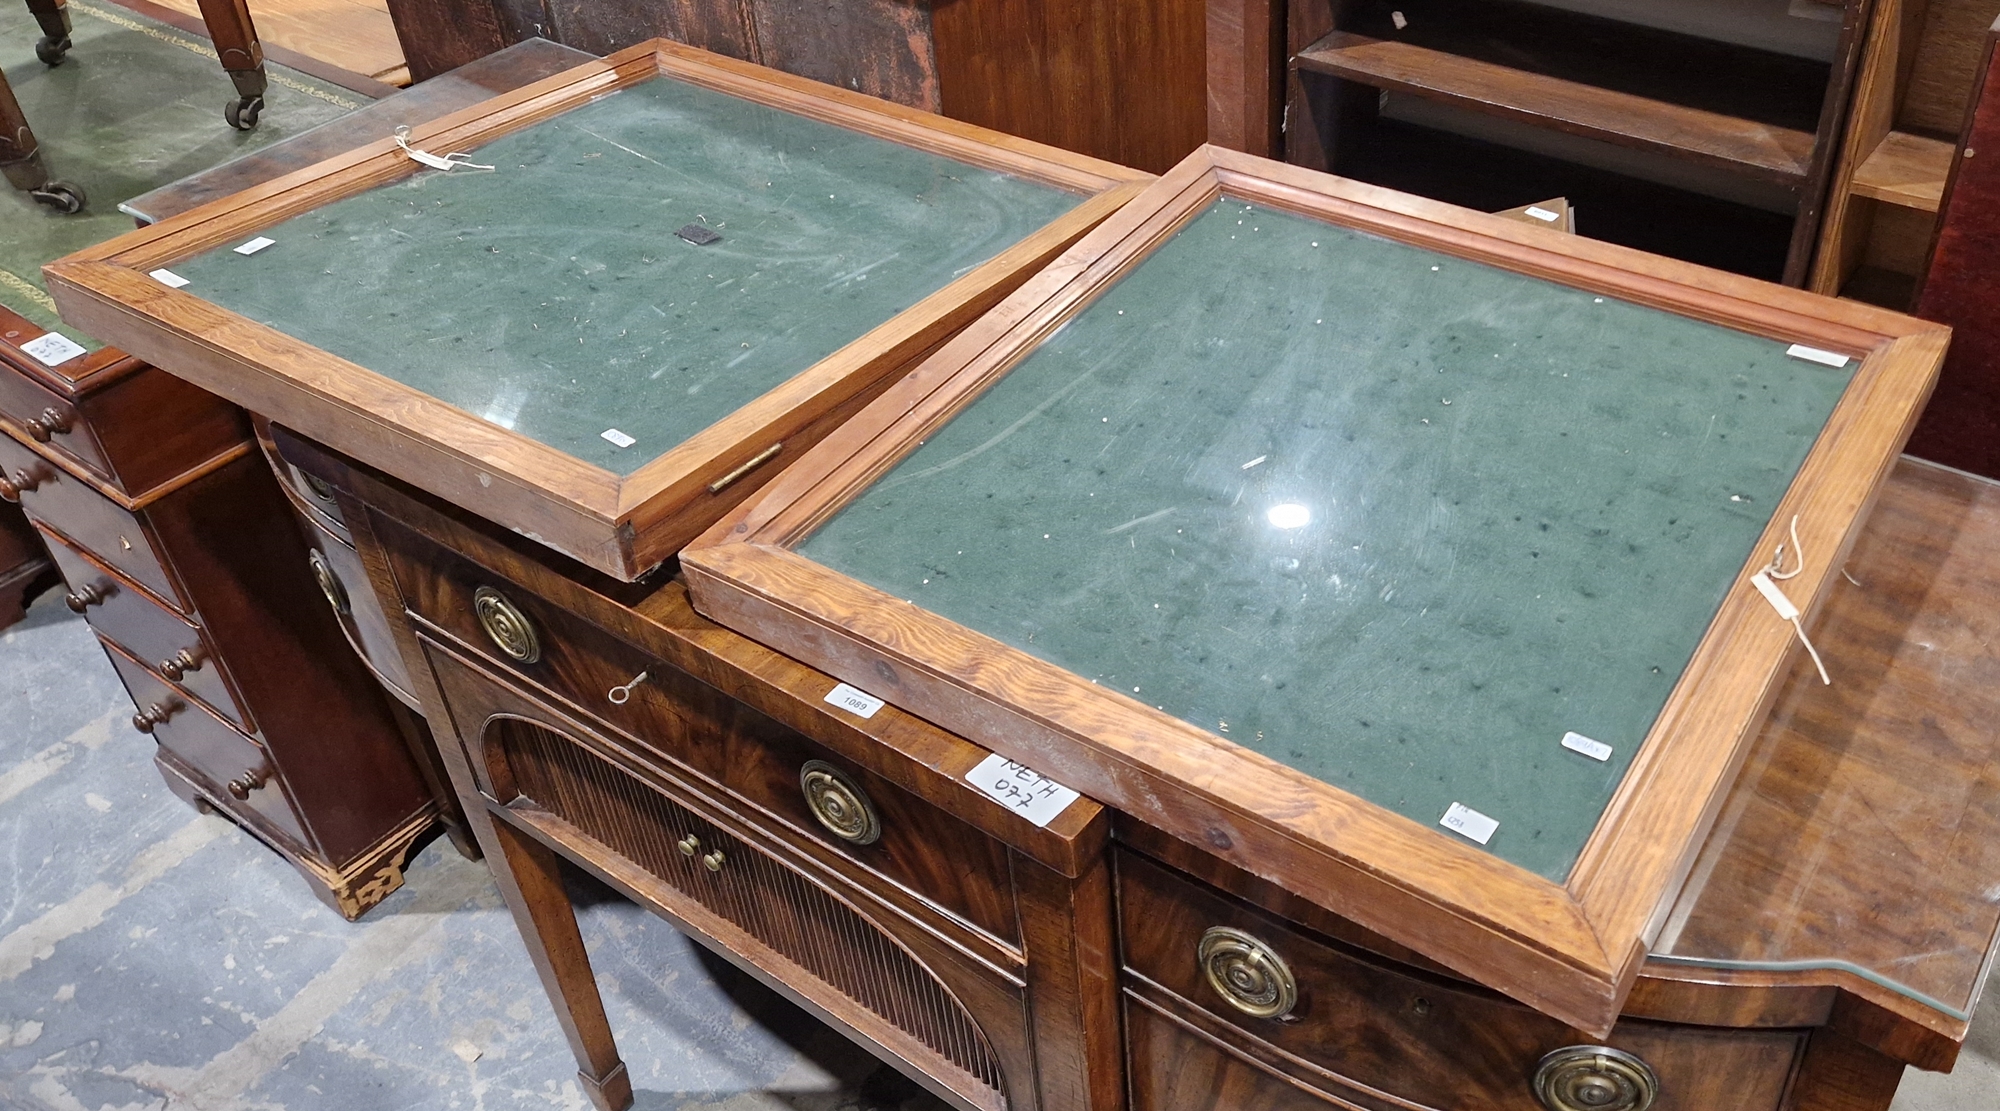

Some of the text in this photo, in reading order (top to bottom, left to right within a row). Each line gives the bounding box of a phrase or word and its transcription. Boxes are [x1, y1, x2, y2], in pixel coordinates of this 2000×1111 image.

[844, 696, 868, 711] 1089
[994, 778, 1034, 808] 077
[1000, 759, 1060, 799] NETH
